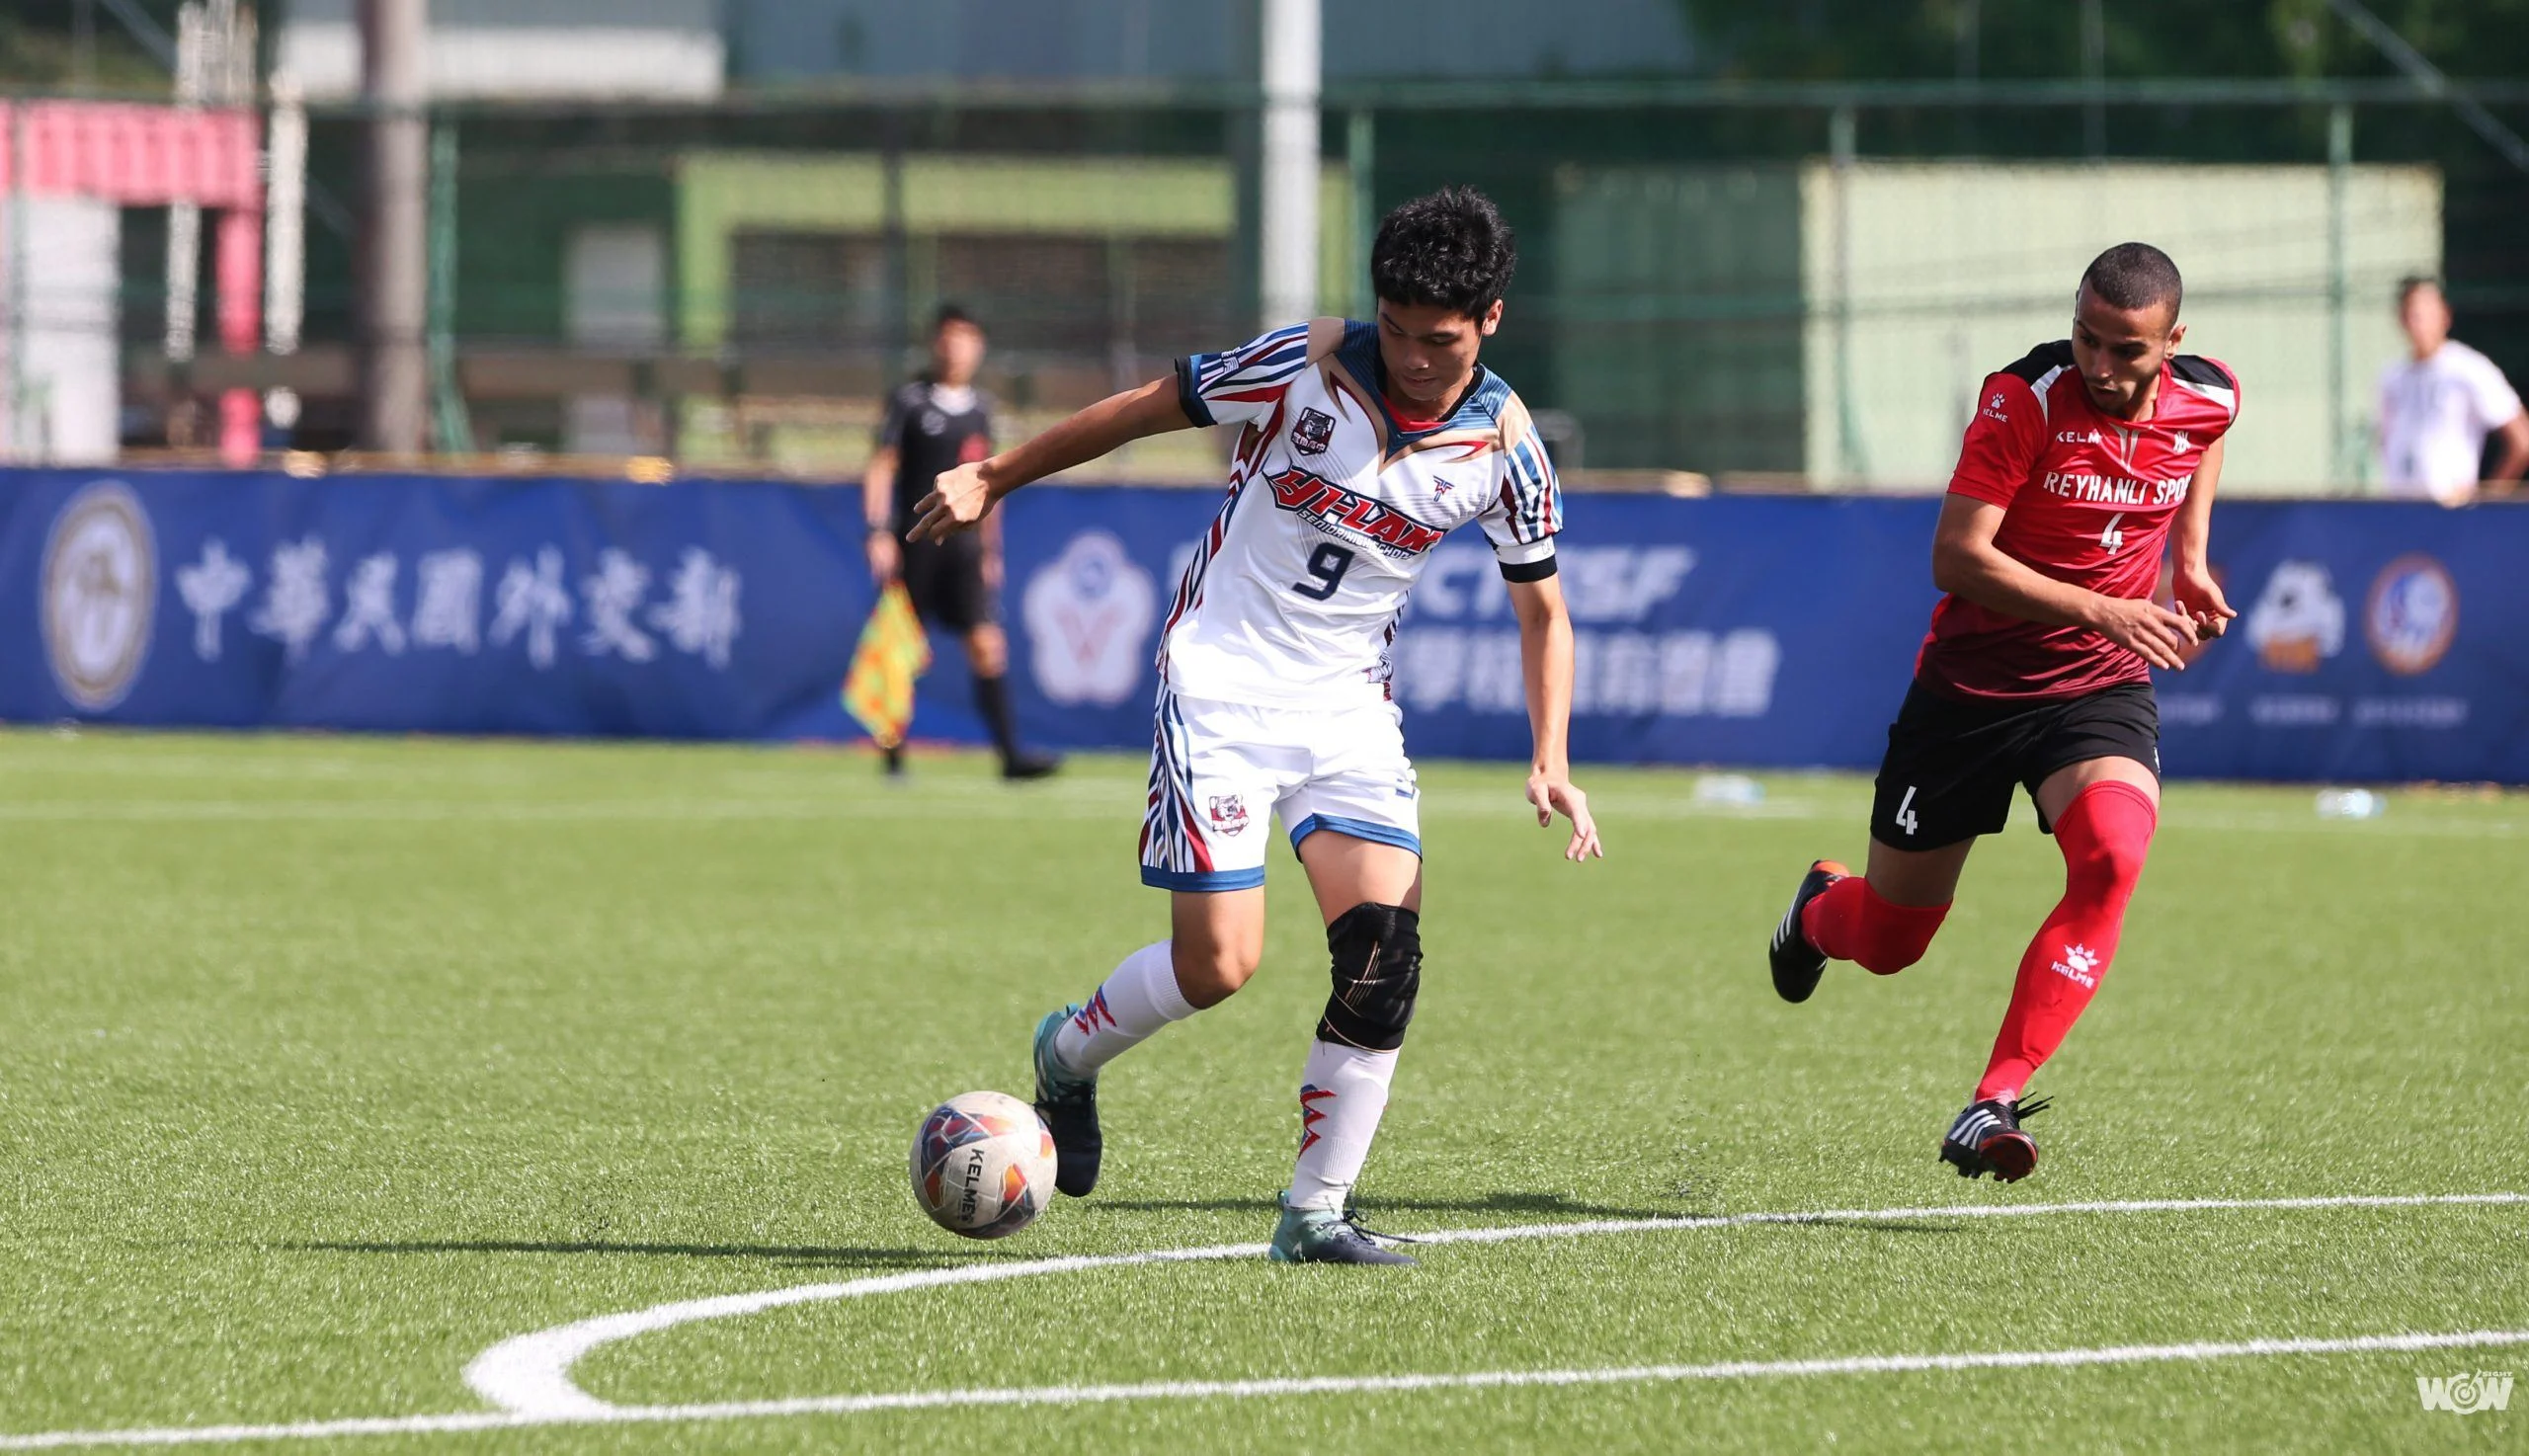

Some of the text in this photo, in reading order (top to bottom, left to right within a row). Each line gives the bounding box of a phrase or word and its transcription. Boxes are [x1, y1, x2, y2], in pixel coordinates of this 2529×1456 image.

[2056, 430, 2101, 445] KELM
[2043, 471, 2149, 505] REYHANLI
[2098, 512, 2126, 555] 4
[1290, 541, 1355, 602] 9
[1895, 785, 1918, 836] 4
[2050, 959, 2095, 990] KELME
[962, 1148, 985, 1215] KELME
